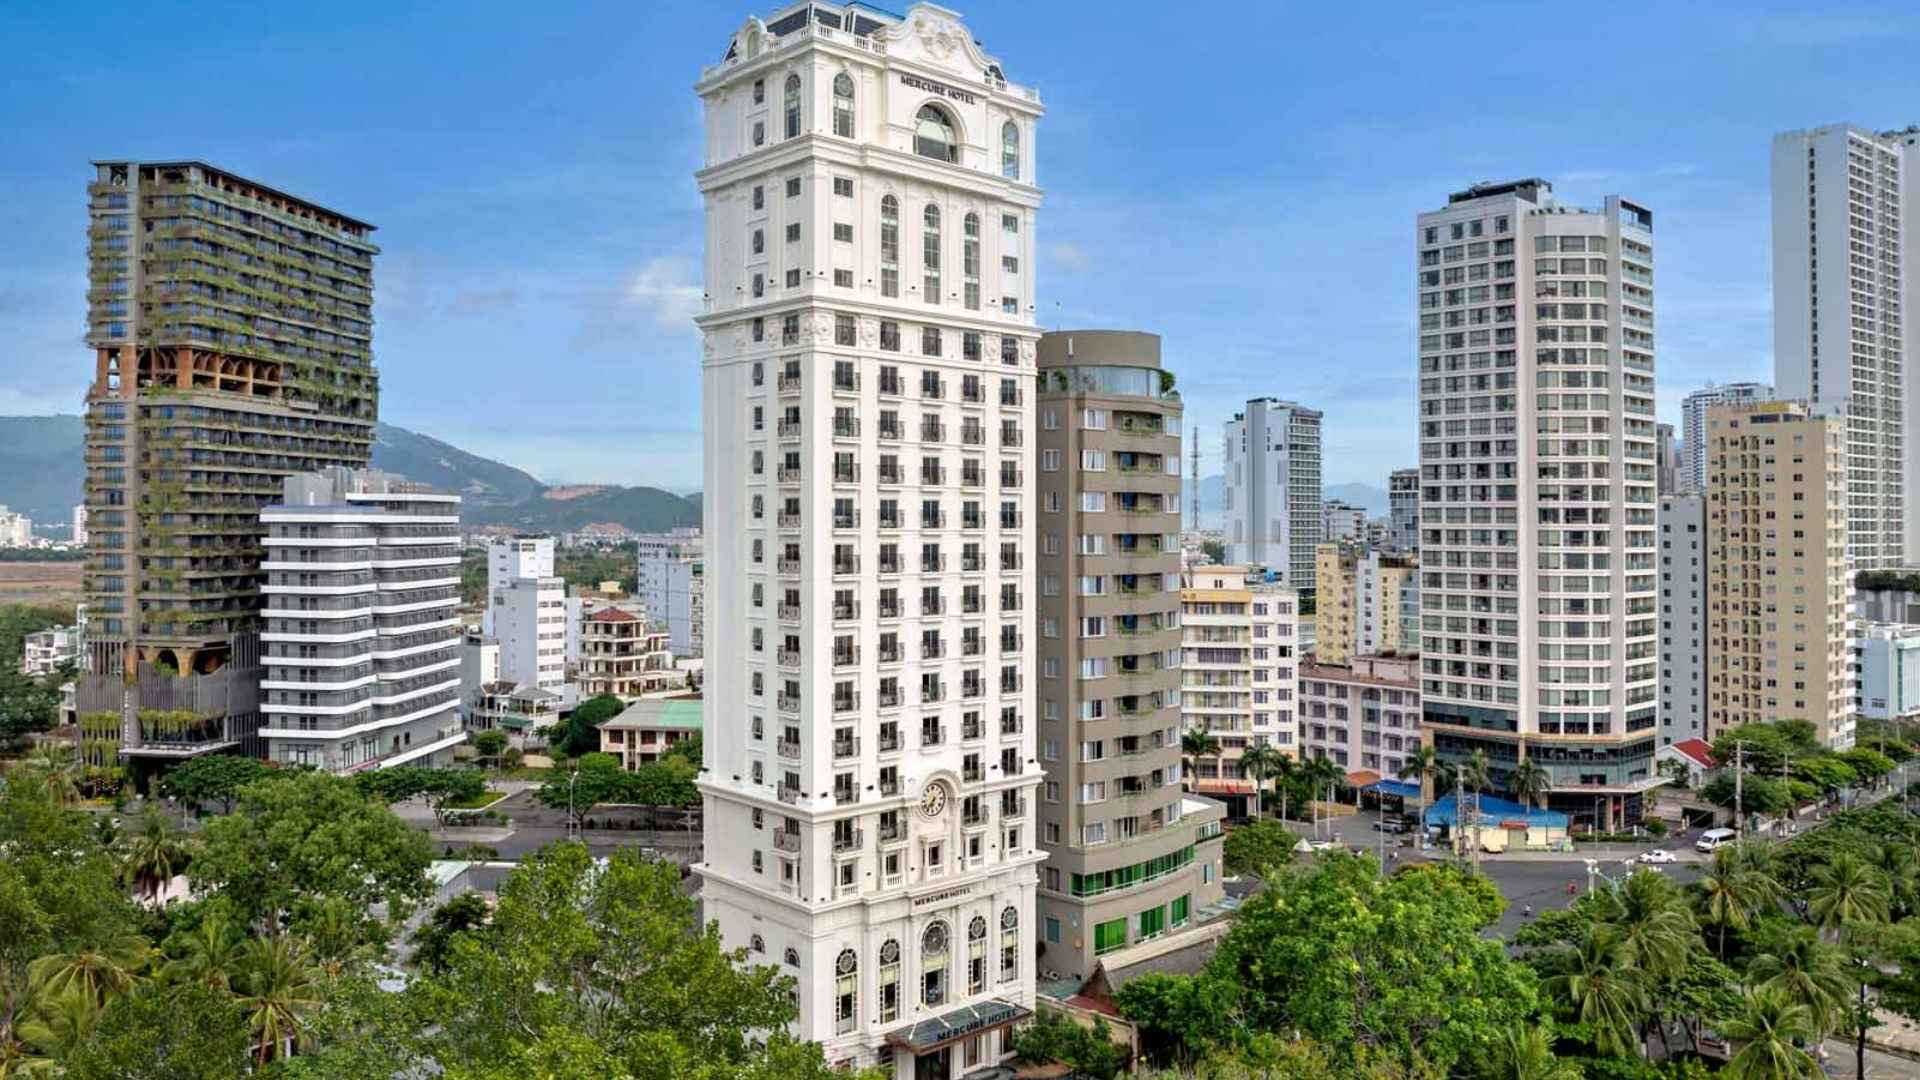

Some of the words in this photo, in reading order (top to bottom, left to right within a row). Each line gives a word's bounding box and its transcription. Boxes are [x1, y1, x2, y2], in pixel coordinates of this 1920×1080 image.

[900, 75, 945, 95] MERCURE
[948, 89, 976, 105] HOTEL
[915, 892, 948, 906] MERCURE
[937, 1018, 985, 1041] MERCURE
[988, 1008, 1017, 1025] HOTEL
